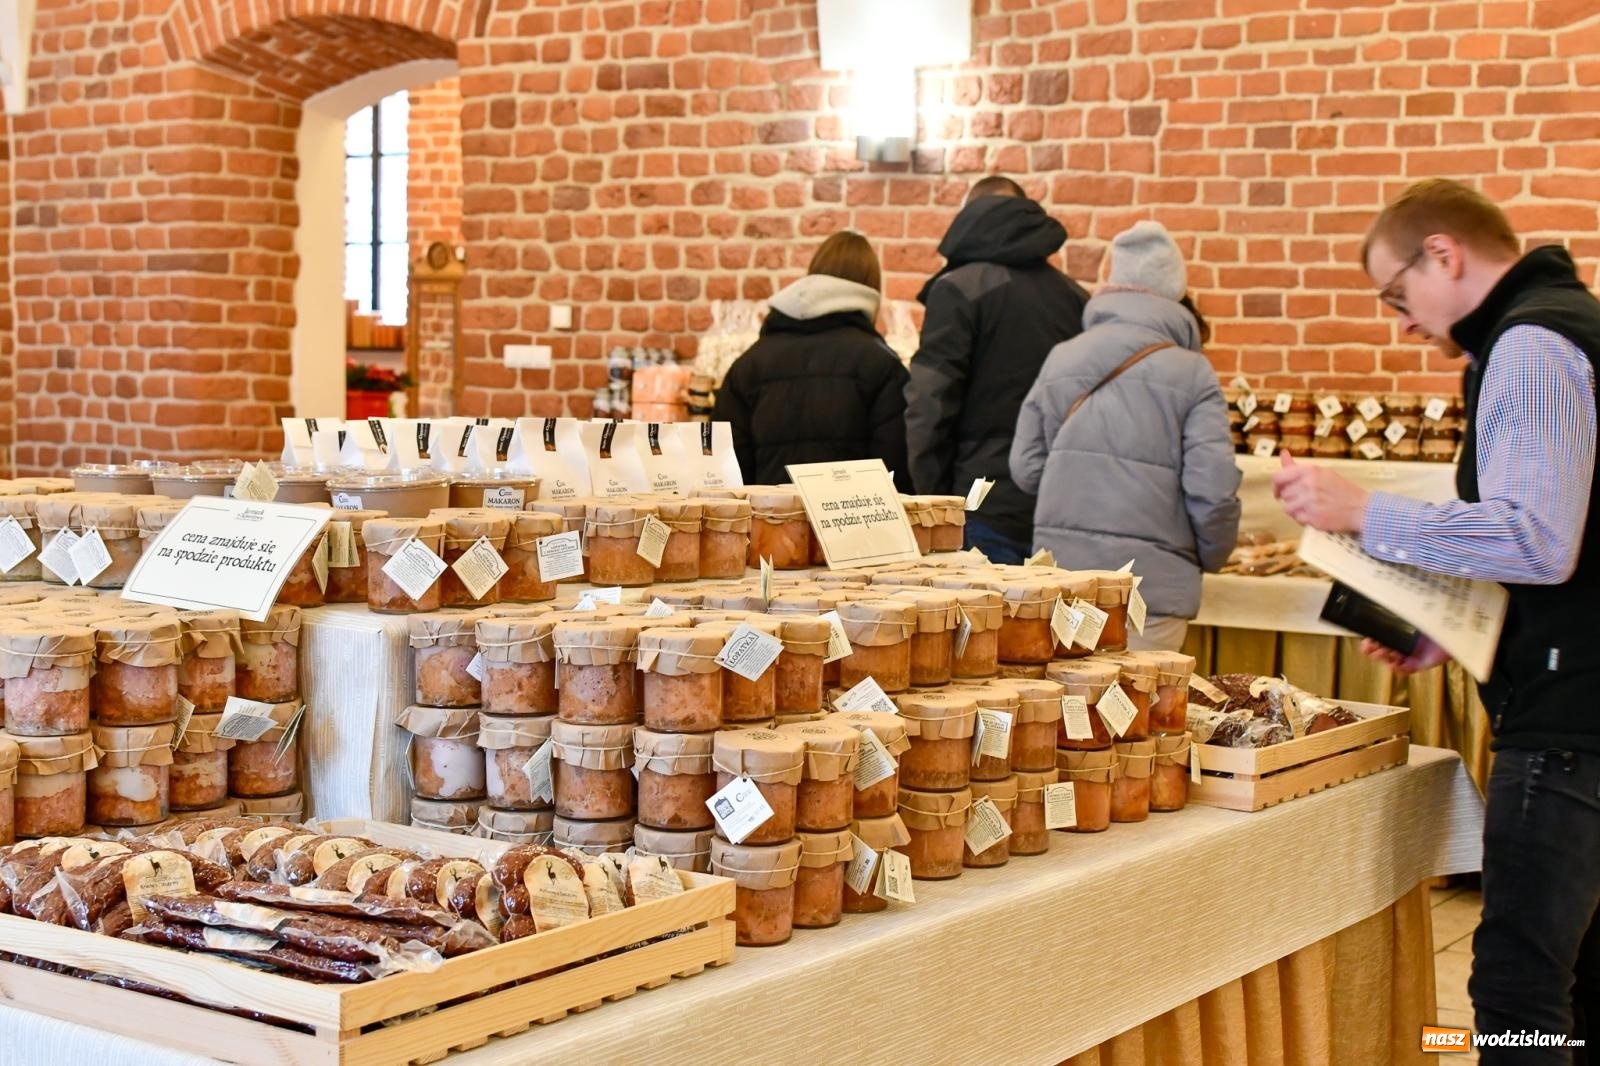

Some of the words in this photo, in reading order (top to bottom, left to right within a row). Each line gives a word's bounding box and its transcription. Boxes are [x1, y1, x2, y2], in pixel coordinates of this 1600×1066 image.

[487, 497, 521, 505] MAKARON
[822, 500, 840, 511] cena
[840, 494, 873, 510] znajduje
[873, 493, 886, 506] się
[820, 519, 832, 529] na
[832, 513, 862, 533] spodzie
[862, 508, 899, 529] produktu
[181, 531, 207, 544] cena
[208, 535, 257, 551] znajduje
[258, 540, 277, 554] się
[157, 546, 172, 558] na
[174, 548, 218, 566] spodzie
[215, 555, 277, 573] produktu
[728, 636, 755, 664] ŁOPATKA
